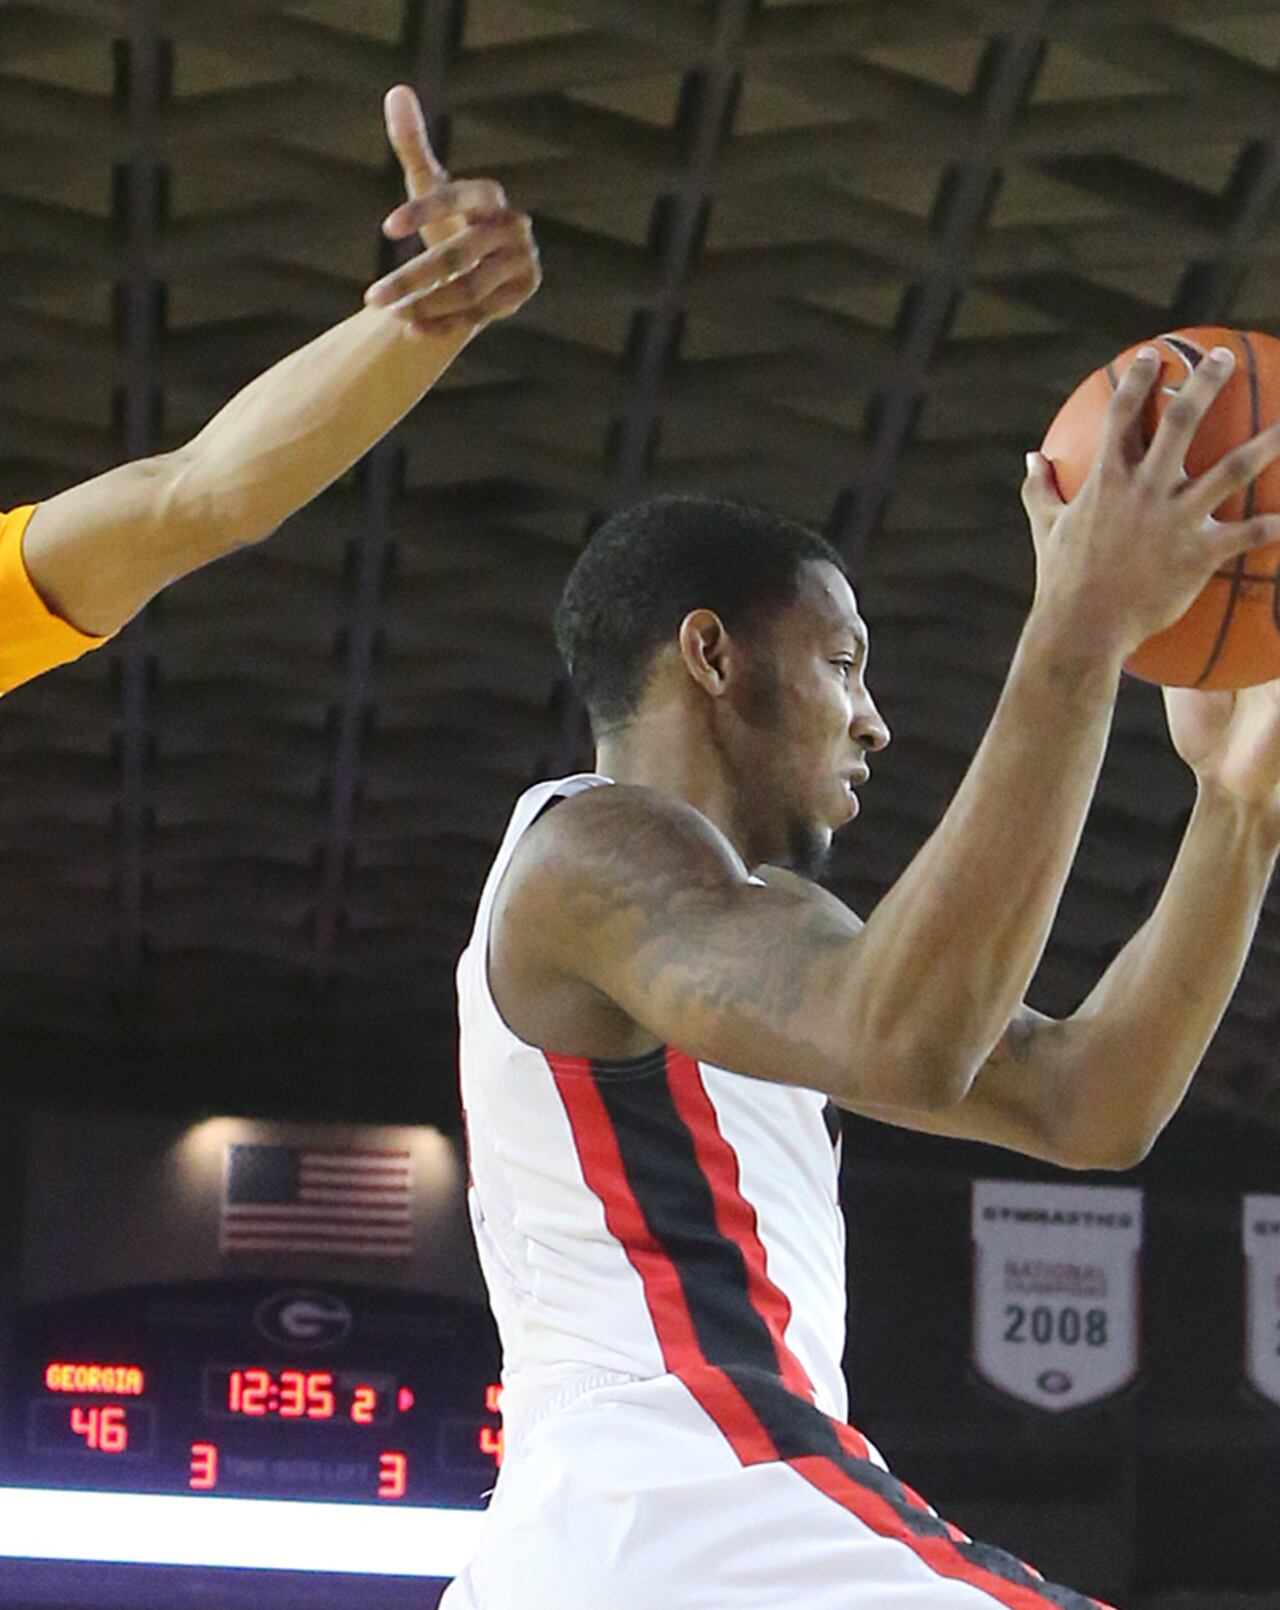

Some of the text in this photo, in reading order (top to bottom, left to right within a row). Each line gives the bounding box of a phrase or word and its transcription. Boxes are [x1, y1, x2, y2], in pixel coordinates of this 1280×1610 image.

[1003, 1304, 1107, 1347] 2008
[45, 1362, 143, 1395] GEORGIA
[229, 1368, 376, 1424] 12:35 2
[70, 1405, 128, 1453] 46
[189, 1442, 217, 1490] 3
[377, 1451, 407, 1499] 3
